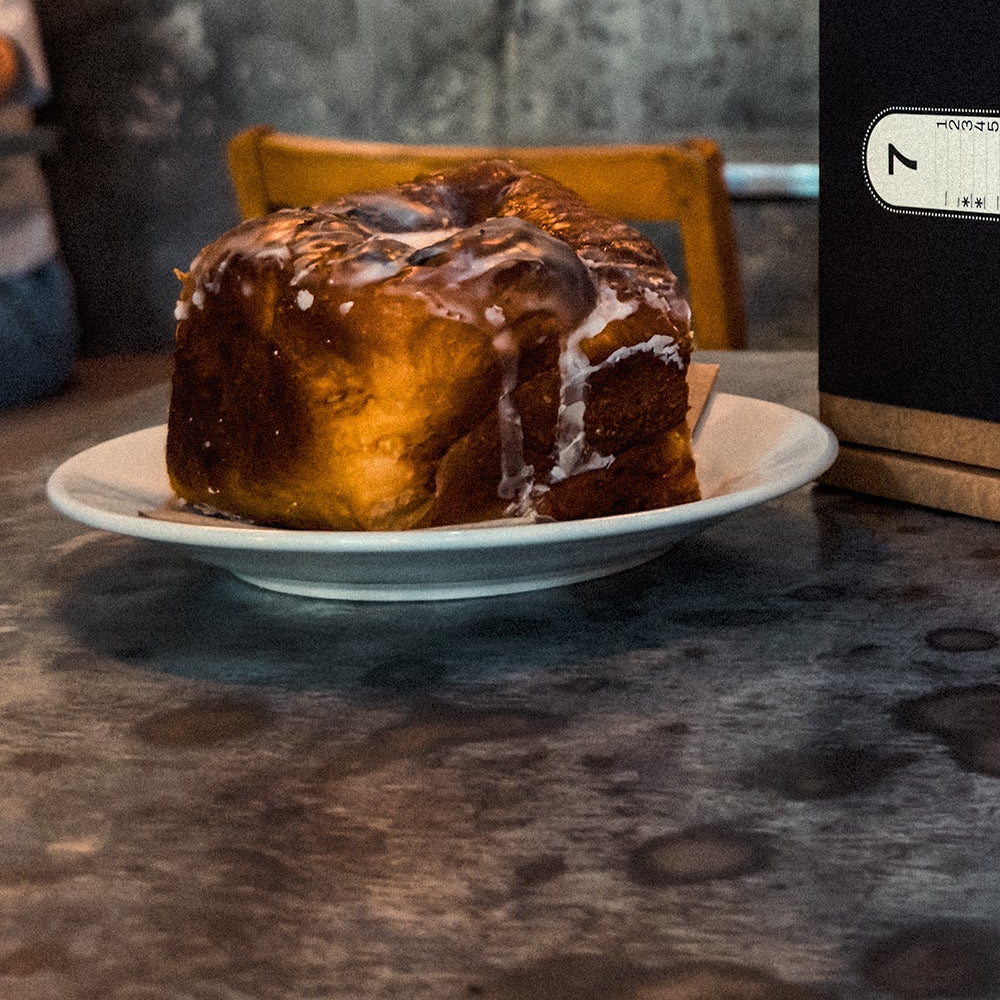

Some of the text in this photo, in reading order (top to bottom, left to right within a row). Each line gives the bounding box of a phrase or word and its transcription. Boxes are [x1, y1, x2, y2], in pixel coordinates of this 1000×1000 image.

[937, 120, 947, 129] 1
[949, 120, 960, 130] 2
[961, 120, 973, 131] 3
[974, 120, 985, 132] 4
[987, 121, 999, 132] 5
[888, 143, 917, 175] 7
